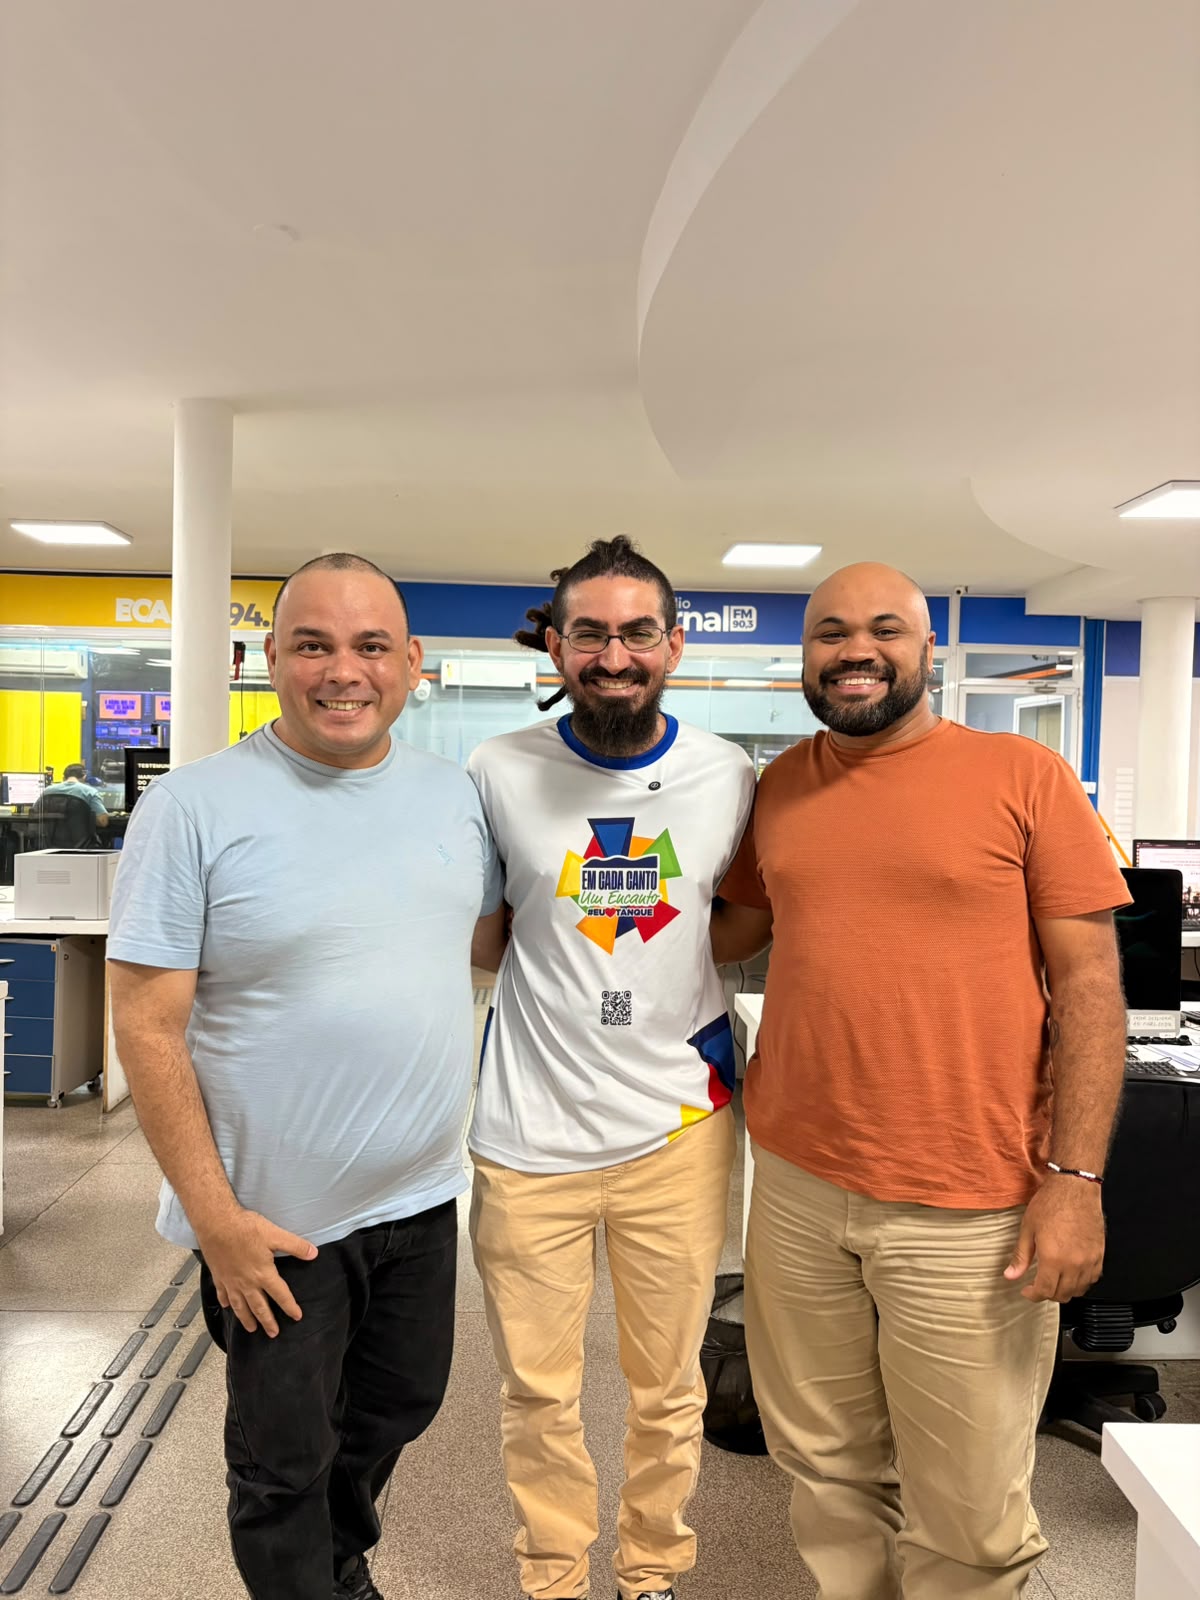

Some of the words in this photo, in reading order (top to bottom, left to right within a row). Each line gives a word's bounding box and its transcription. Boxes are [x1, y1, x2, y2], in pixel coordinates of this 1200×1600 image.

[733, 608, 752, 619] FM
[582, 870, 596, 890] EM
[598, 870, 624, 890] CADA
[626, 870, 657, 890] CANTO
[580, 890, 603, 904] Um
[608, 890, 660, 905] Encanto
[616, 908, 653, 916] TANQUE
